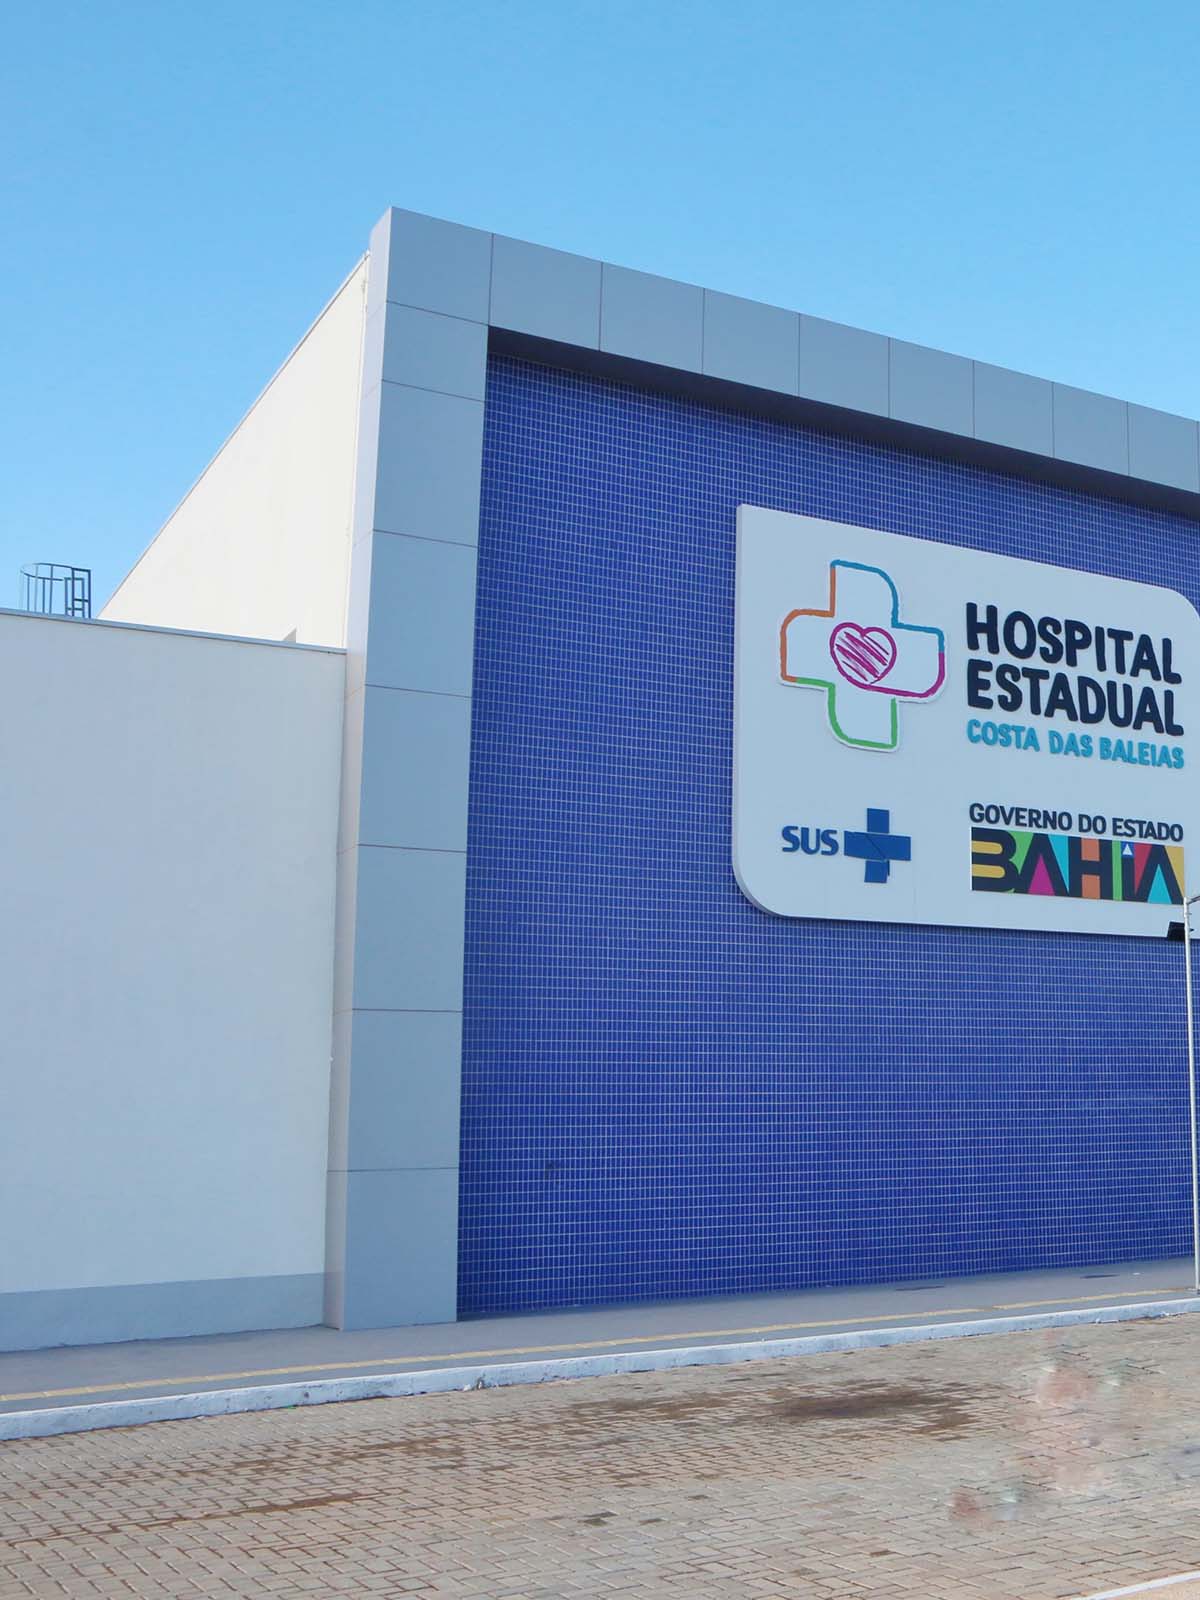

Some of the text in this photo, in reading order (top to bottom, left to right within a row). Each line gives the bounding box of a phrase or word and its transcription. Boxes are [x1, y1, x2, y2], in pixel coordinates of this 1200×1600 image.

[966, 602, 1182, 685] HOSPITAL
[966, 658, 1184, 737] ESTADUAL
[967, 719, 1184, 770] COSTA DAS BALEIAS
[781, 825, 839, 856] SUS
[969, 803, 1184, 843] GOVERNO DO ESTADO
[971, 827, 1185, 906] BAHIA
